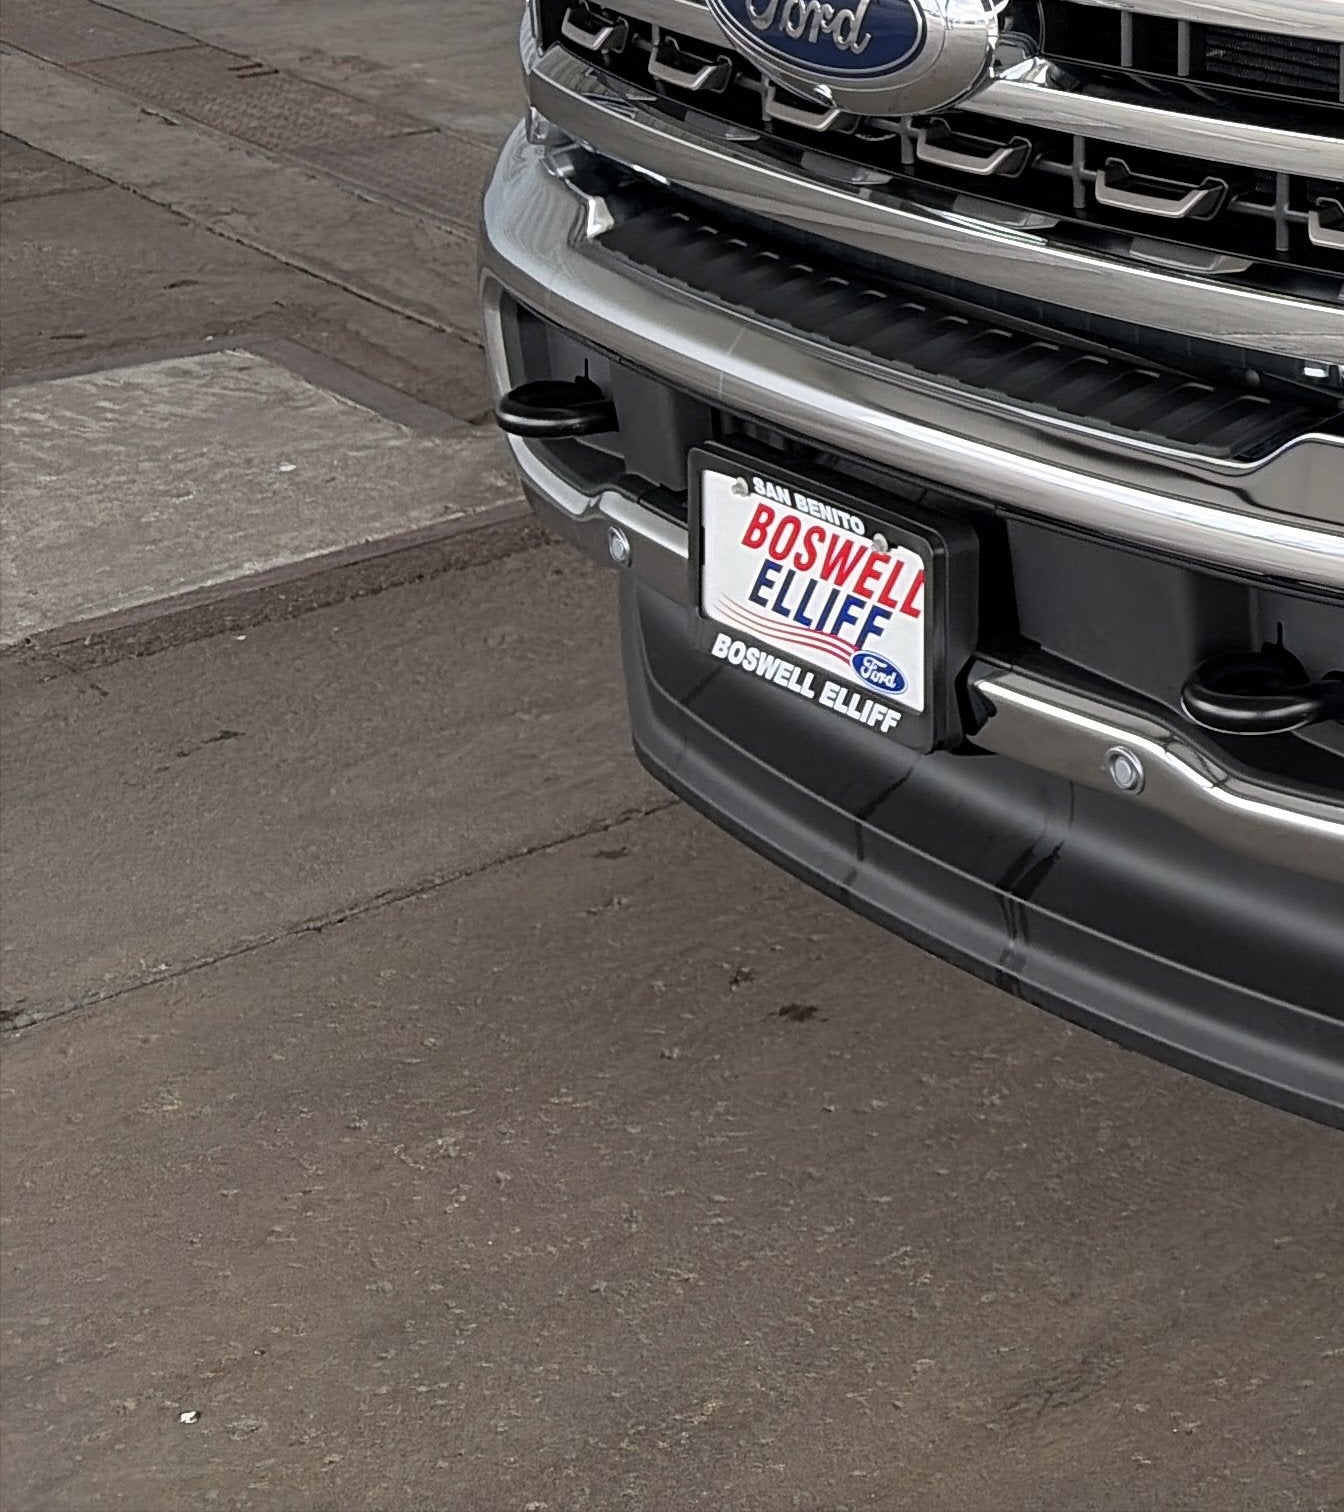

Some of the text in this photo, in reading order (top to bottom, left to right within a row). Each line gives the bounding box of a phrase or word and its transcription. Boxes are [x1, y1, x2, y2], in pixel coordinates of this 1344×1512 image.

[751, 476, 866, 536] SAN BENITO
[741, 502, 926, 619] BOSWELL
[748, 558, 893, 650] ELLIFF
[711, 633, 902, 733] BOSWELL ELLIFF
[858, 653, 898, 690] Ford
